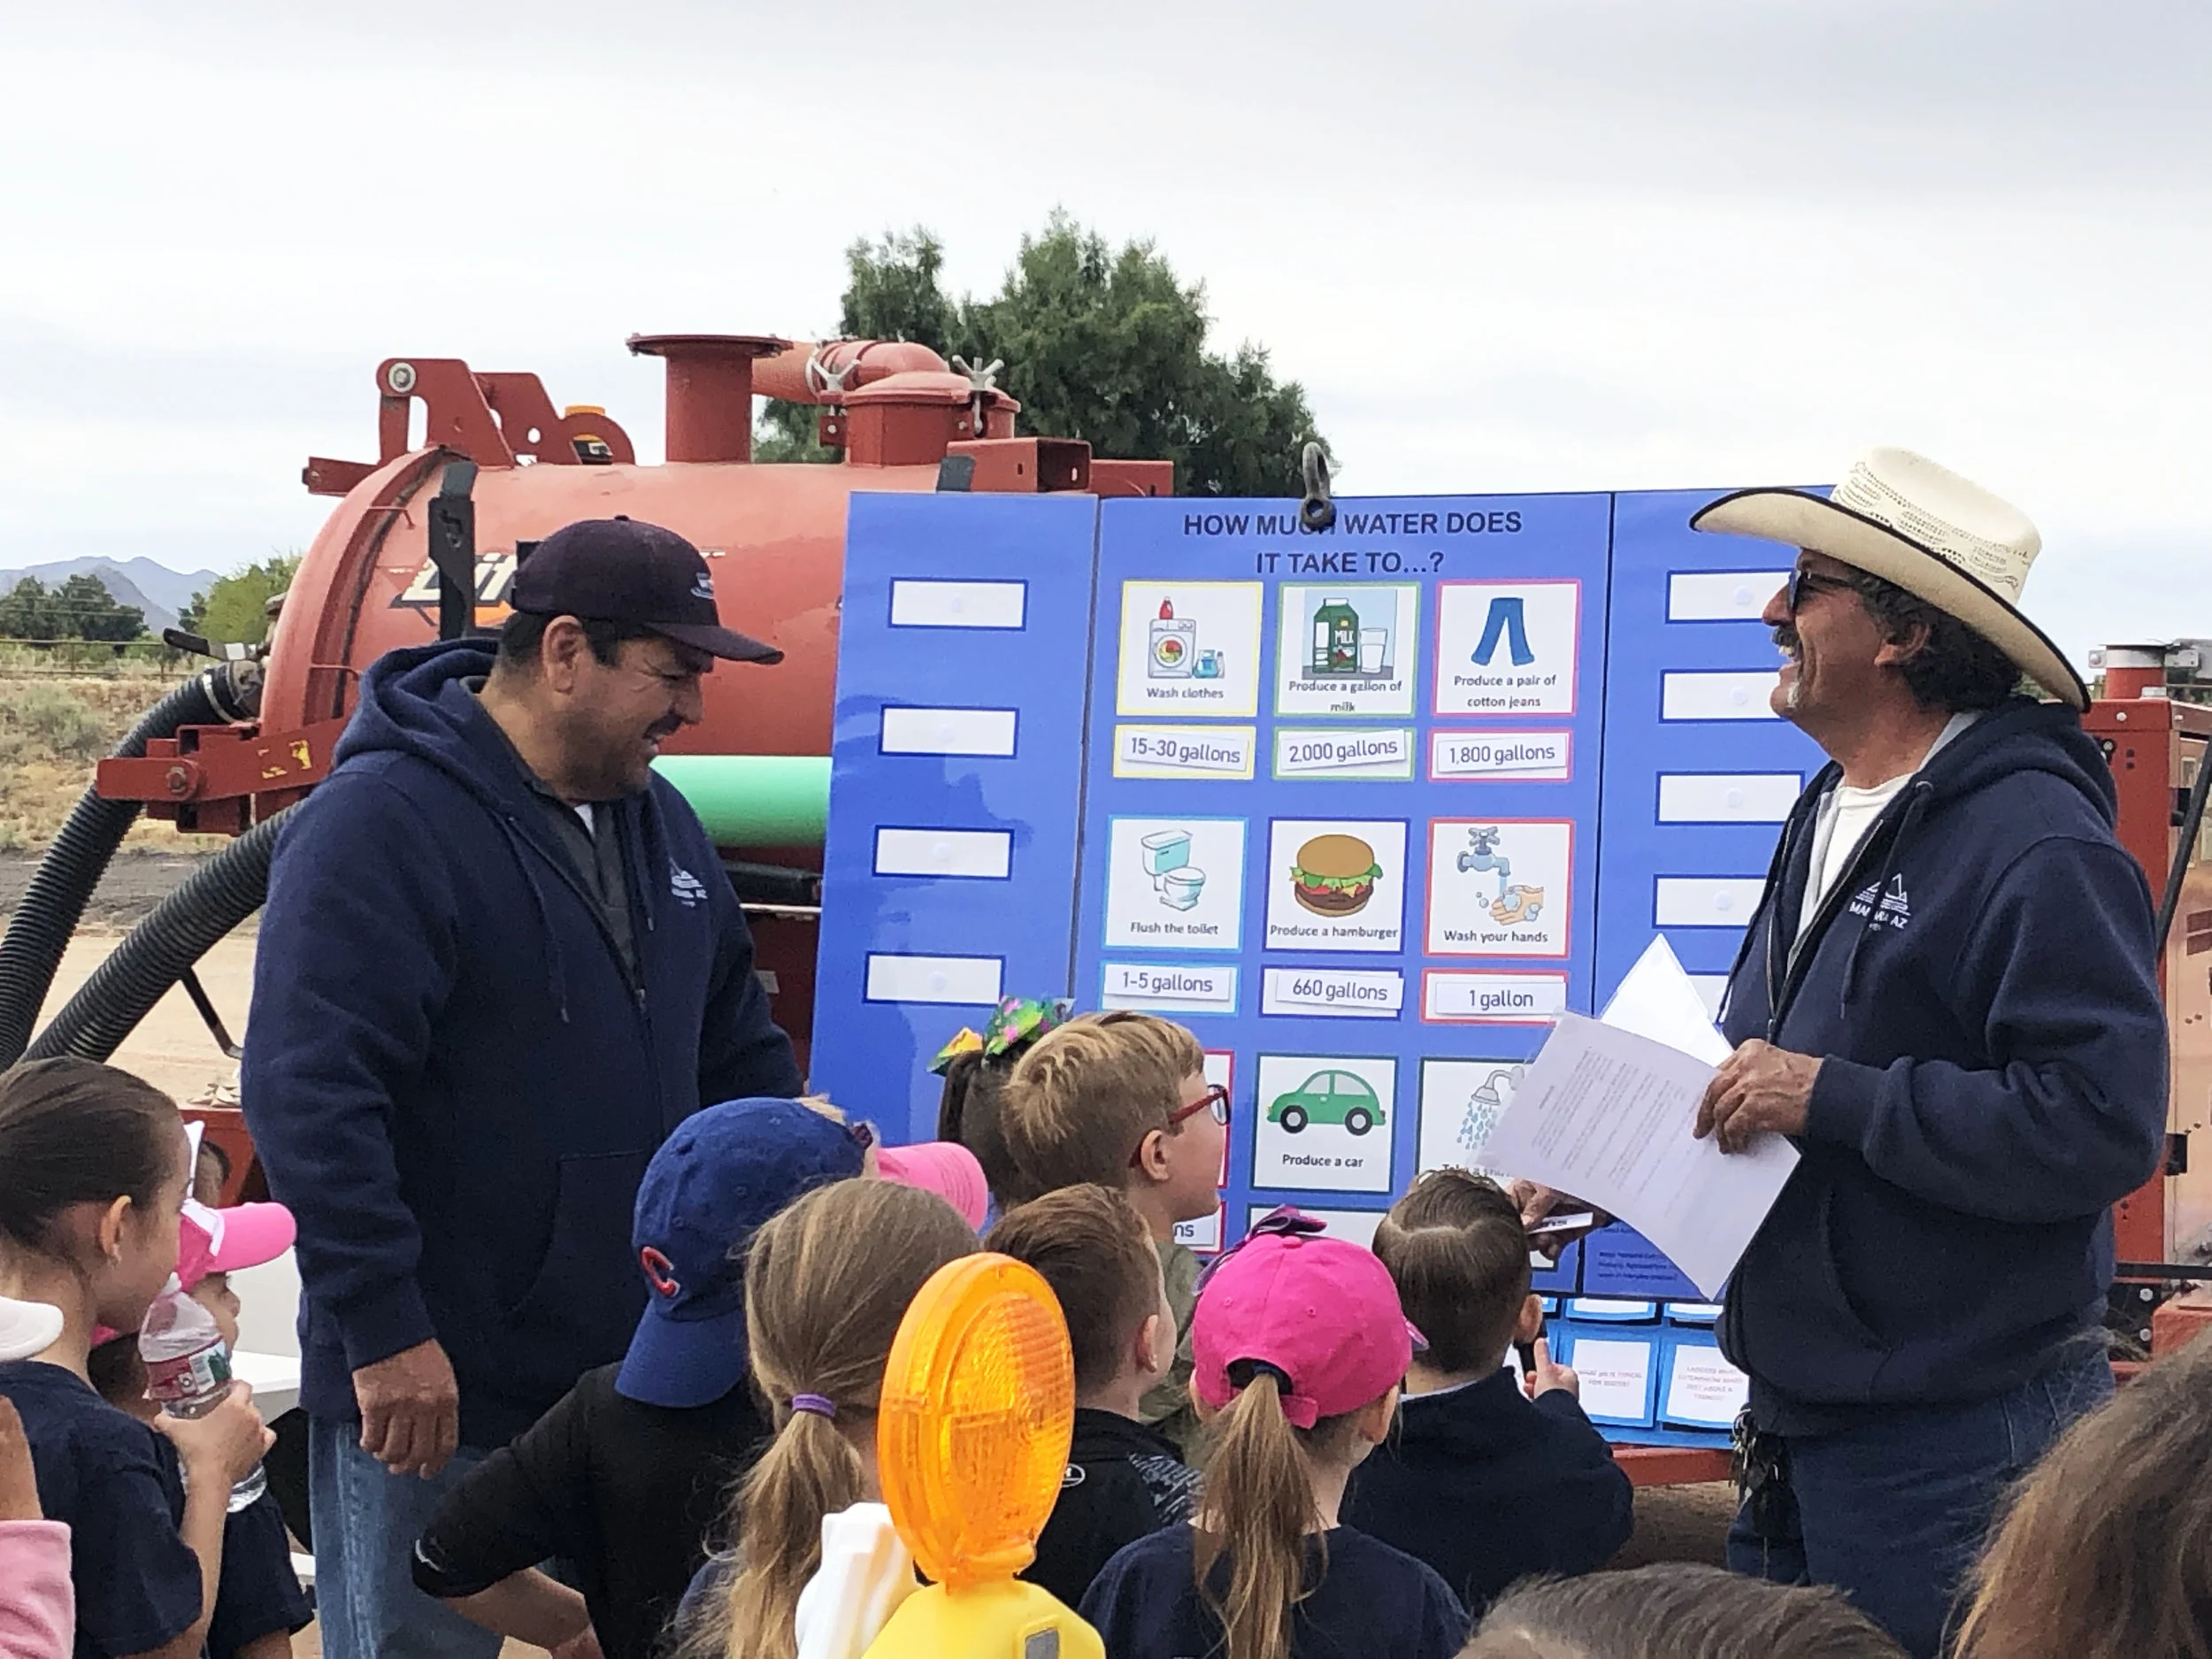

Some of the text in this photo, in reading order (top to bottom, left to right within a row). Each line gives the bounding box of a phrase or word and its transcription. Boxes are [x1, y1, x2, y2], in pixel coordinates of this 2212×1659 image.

[1184, 514, 1249, 536] HOW
[1343, 512, 1439, 535] WATER
[1446, 511, 1523, 534] DOES
[1256, 550, 1445, 574] IT TAKE TO...?
[1288, 680, 1337, 692] Produce
[1340, 683, 1348, 692] a
[1389, 680, 1402, 692] of
[1454, 673, 1556, 688] Produce a pair of
[1147, 687, 1225, 699] Wash clothes
[1330, 701, 1356, 712] milk
[1467, 695, 1541, 710] cotton jeans
[1131, 735, 1241, 764] 15-30 gallons
[1336, 740, 1399, 763] gallons
[1449, 743, 1556, 766] 1,800 gallons
[1131, 921, 1218, 935] Flush the toilet
[1270, 925, 1399, 941] Produce a hamburger
[1443, 929, 1549, 944] Wash your hands
[1123, 971, 1213, 994] 1-5 gallons
[1293, 978, 1387, 1002] 660 gallons
[1469, 989, 1534, 1011] 1 gallon
[1282, 1154, 1364, 1168] Produce a car
